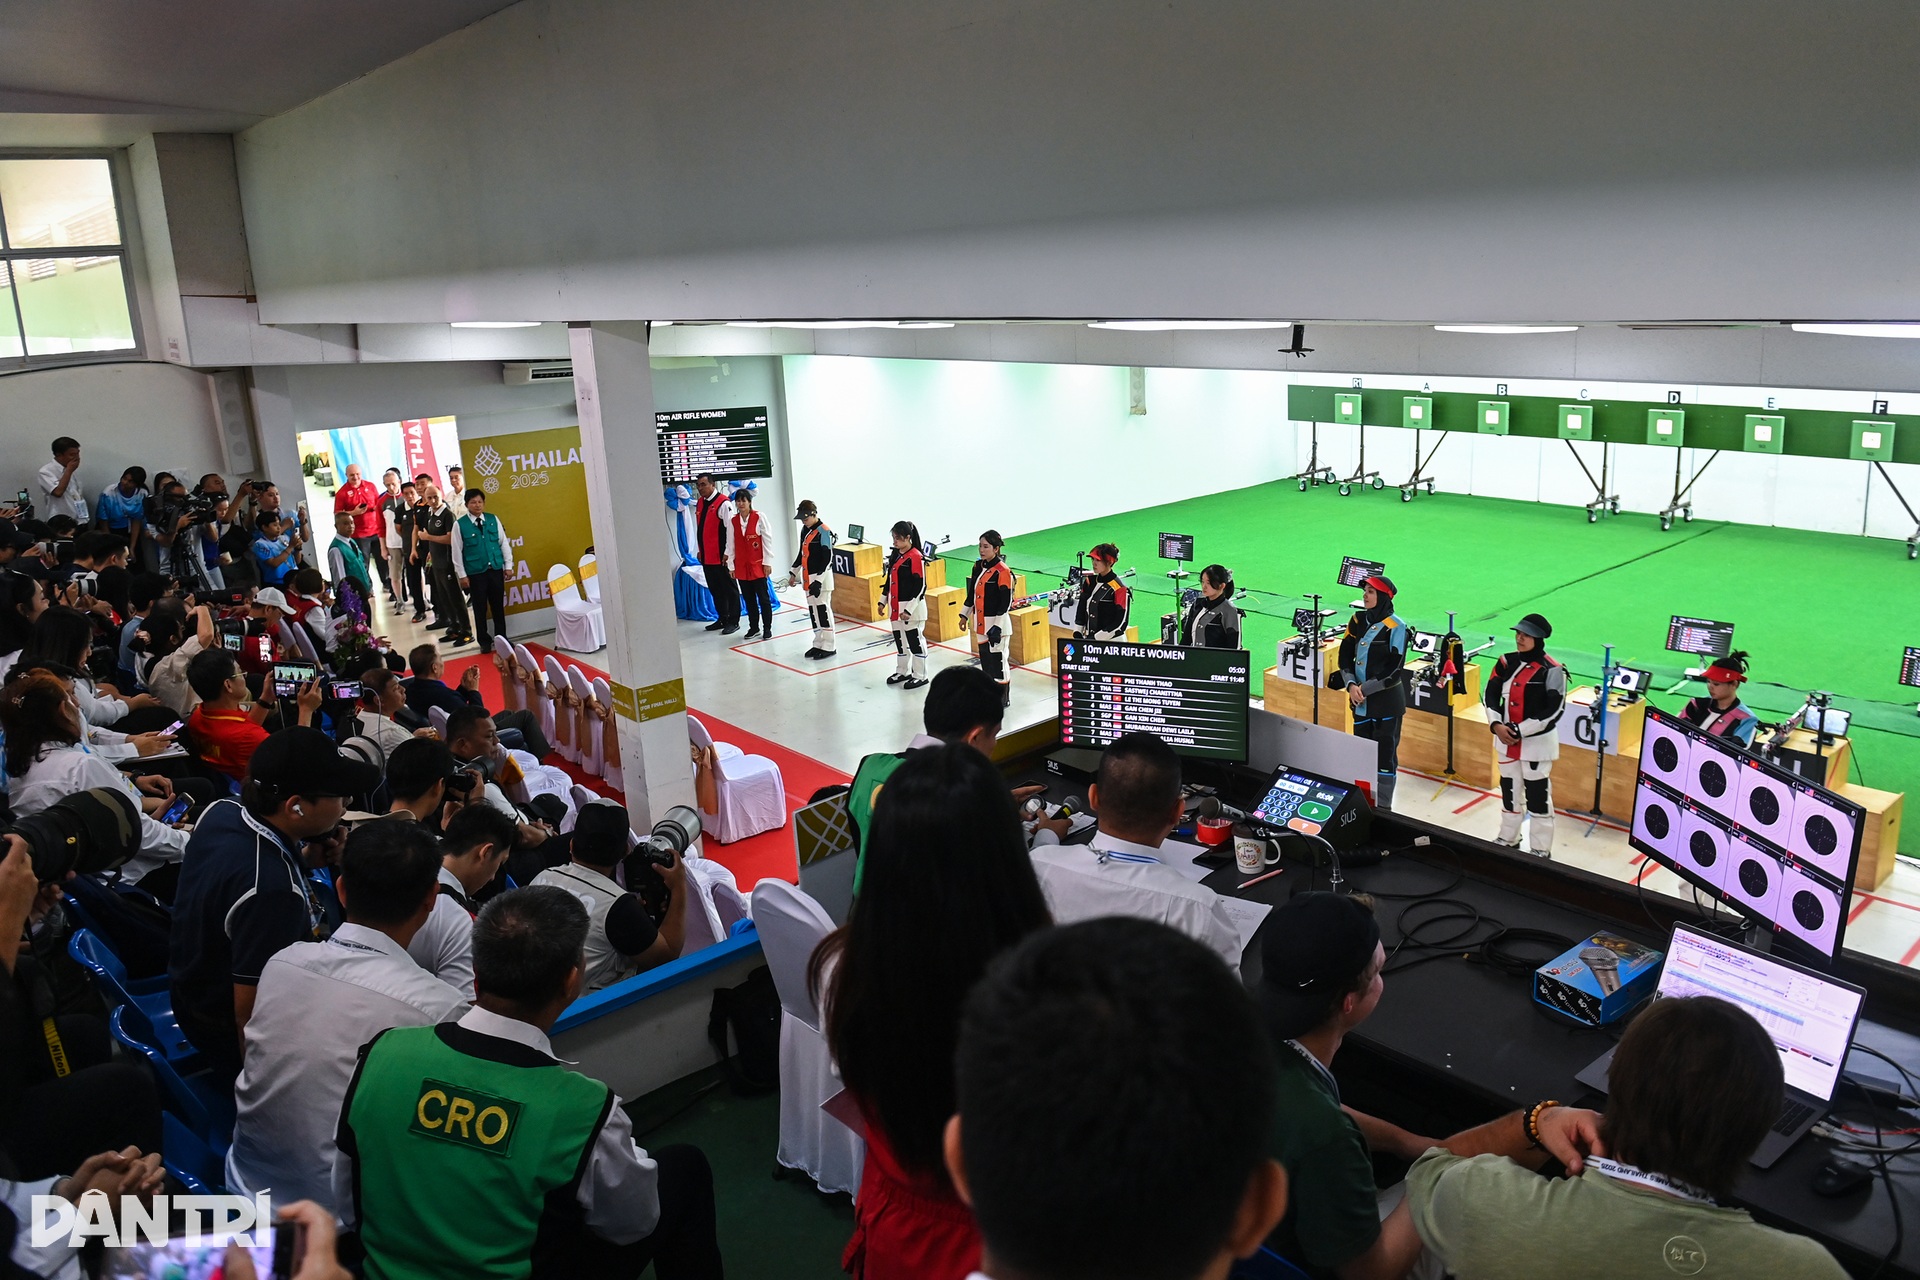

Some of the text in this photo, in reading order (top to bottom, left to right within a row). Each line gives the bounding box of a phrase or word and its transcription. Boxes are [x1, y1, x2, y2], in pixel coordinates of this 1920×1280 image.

[1424, 382, 1430, 390] A
[1499, 385, 1507, 396] B
[1580, 389, 1588, 399] C
[1669, 392, 1679, 404] D
[1768, 398, 1775, 408] E
[1876, 402, 1885, 413] F
[507, 446, 586, 472] THAILA
[510, 471, 550, 490] 2025
[835, 554, 850, 574] R1
[1059, 604, 1070, 625] C
[1083, 645, 1185, 660] 10m AIR RIFLE WOMEN
[1293, 651, 1306, 680] E
[1415, 680, 1432, 706] F
[1574, 715, 1596, 745] G
[1340, 808, 1356, 827] SIUS
[51, 1045, 66, 1075] Nikon
[418, 1089, 509, 1145] CRO
[1601, 1162, 1616, 1171] 2025
[1617, 1167, 1648, 1180] THAILAND
